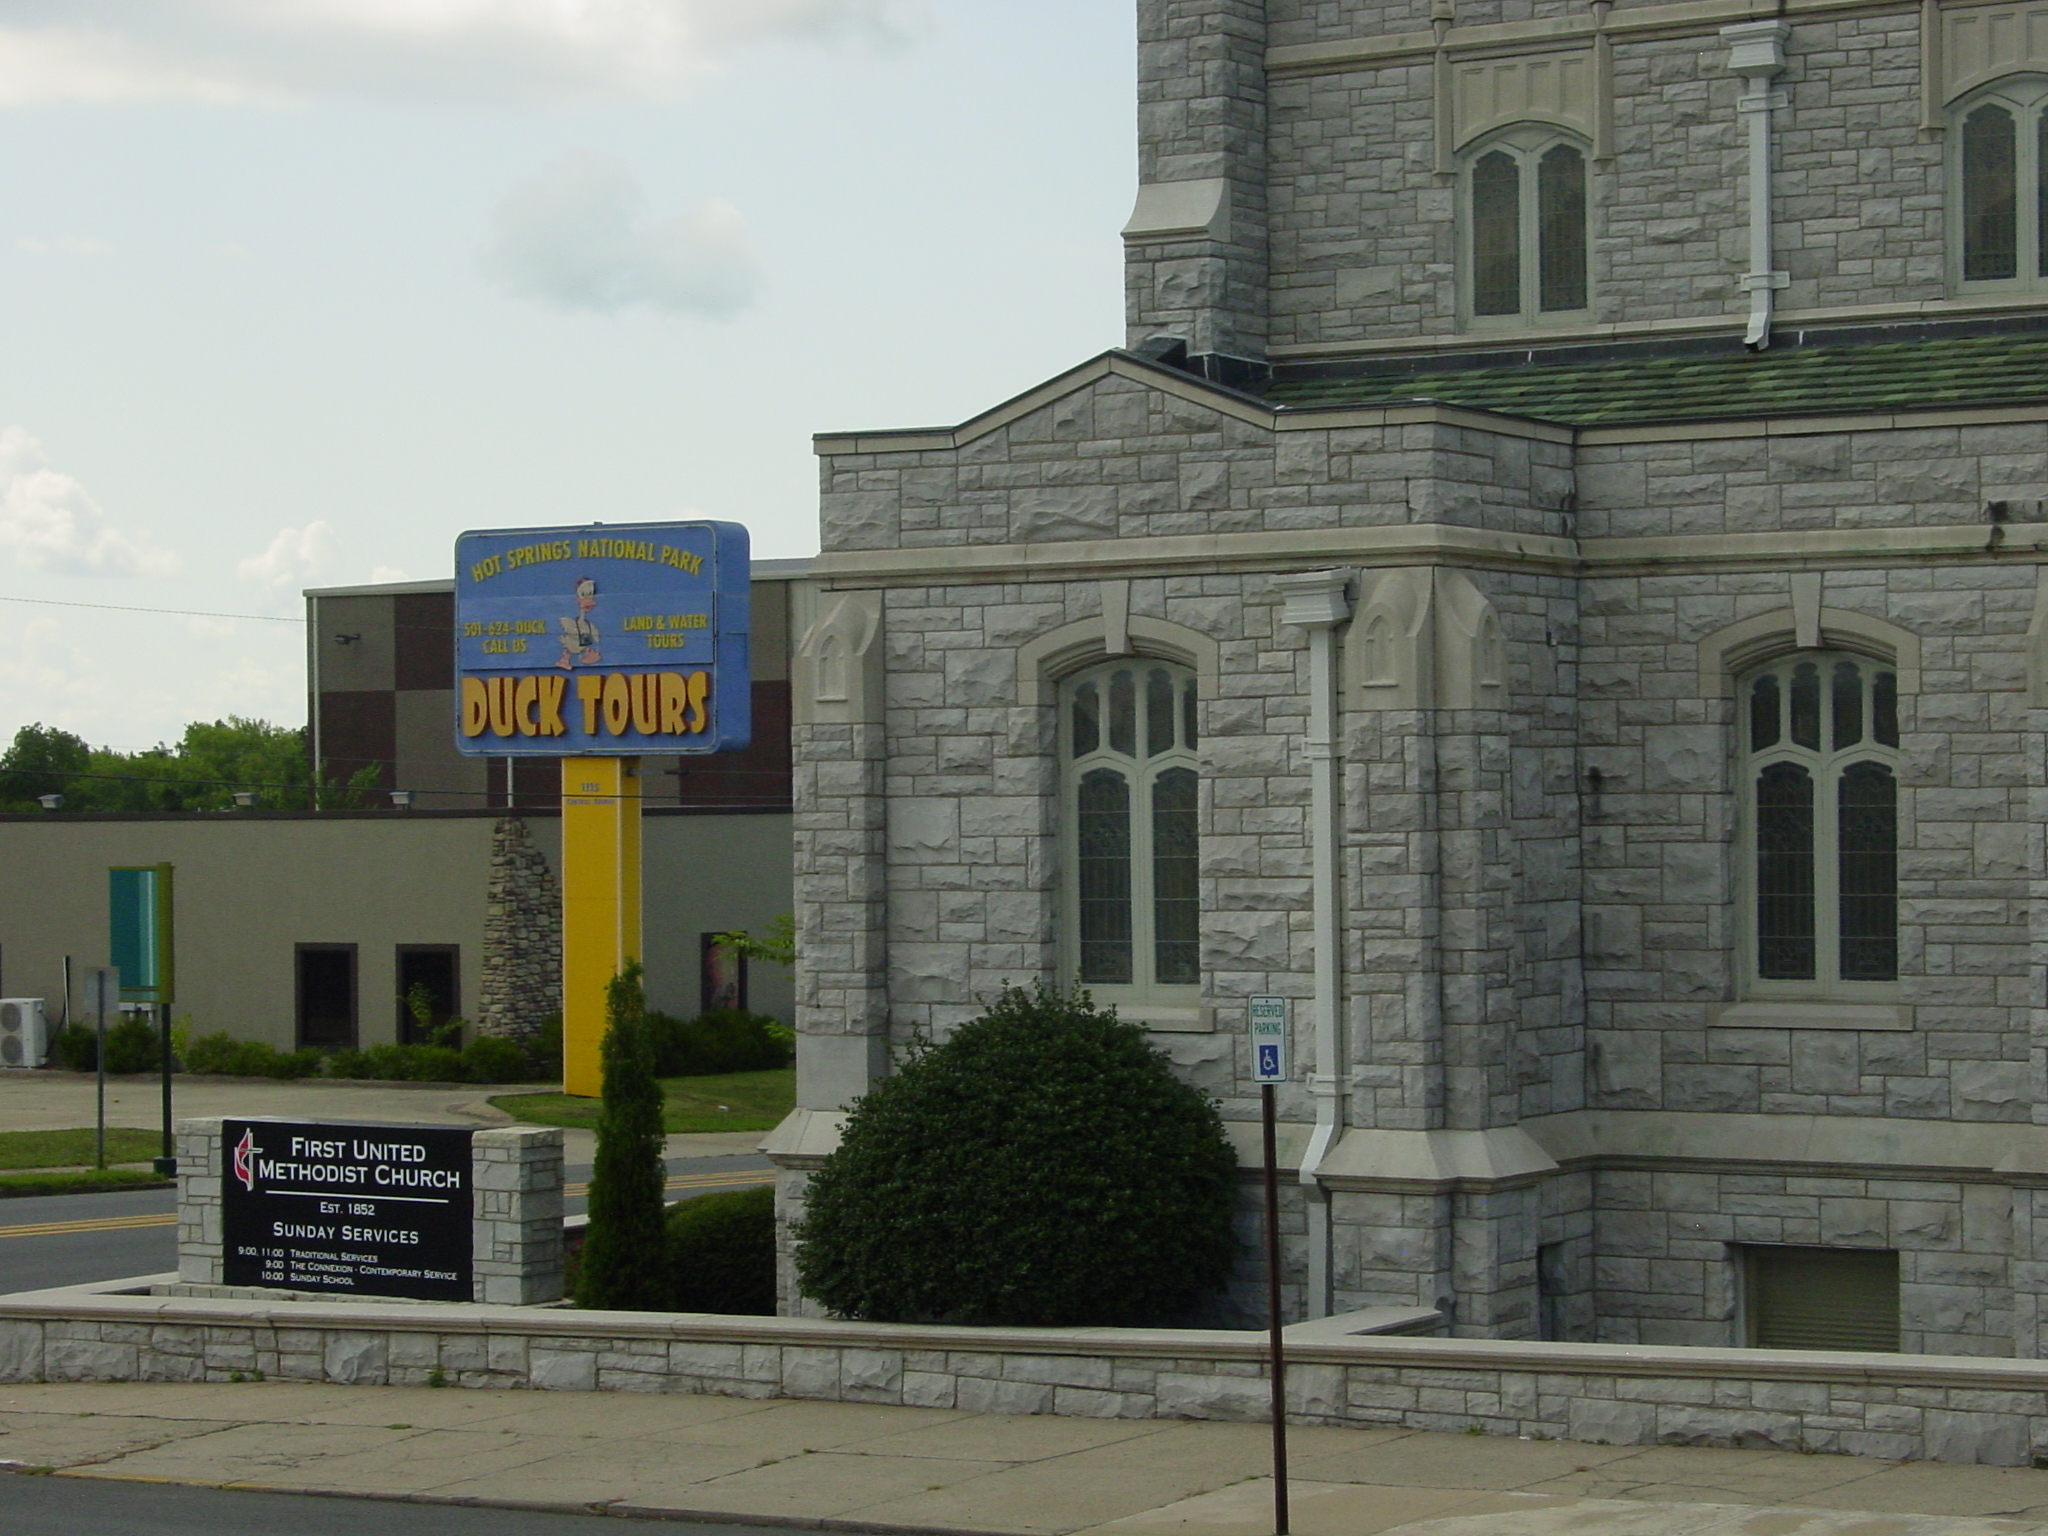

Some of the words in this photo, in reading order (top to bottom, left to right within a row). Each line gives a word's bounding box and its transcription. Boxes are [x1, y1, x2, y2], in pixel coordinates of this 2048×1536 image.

[471, 555, 503, 583] HOT
[507, 541, 571, 569] SPRINGS
[578, 539, 655, 561] NATIONAL
[661, 545, 703, 575] PARK
[624, 616, 652, 631] LAND
[656, 615, 665, 630] &
[669, 614, 707, 629] WATER
[483, 640, 508, 654] CALL
[513, 639, 527, 652] US
[647, 633, 685, 648] TOURS
[462, 675, 566, 737] DUCK
[577, 671, 708, 736] TOURS
[1252, 1004, 1283, 1017] RESERVED
[1254, 1022, 1281, 1034] PARKING
[291, 1136, 346, 1159] FIRST
[353, 1140, 426, 1163] UNITED
[258, 1159, 368, 1183] METHODIST
[375, 1165, 460, 1188] CHURCH
[320, 1201, 344, 1215] EST.
[348, 1204, 375, 1216] 1852
[273, 1221, 335, 1239] SUNDAY
[341, 1225, 419, 1244] SERVICES
[261, 1247, 284, 1257] 11:00
[290, 1249, 339, 1260] TRADITIONAL
[341, 1252, 378, 1263] SERVICES
[261, 1271, 284, 1280] 10:00
[290, 1273, 321, 1283] SUNDAY
[323, 1274, 354, 1285] SCHOOL
[265, 1260, 284, 1269] 9:00
[290, 1261, 305, 1270] THE
[360, 1265, 421, 1277] CONTEMPORARY
[424, 1269, 458, 1280] SERVICE
